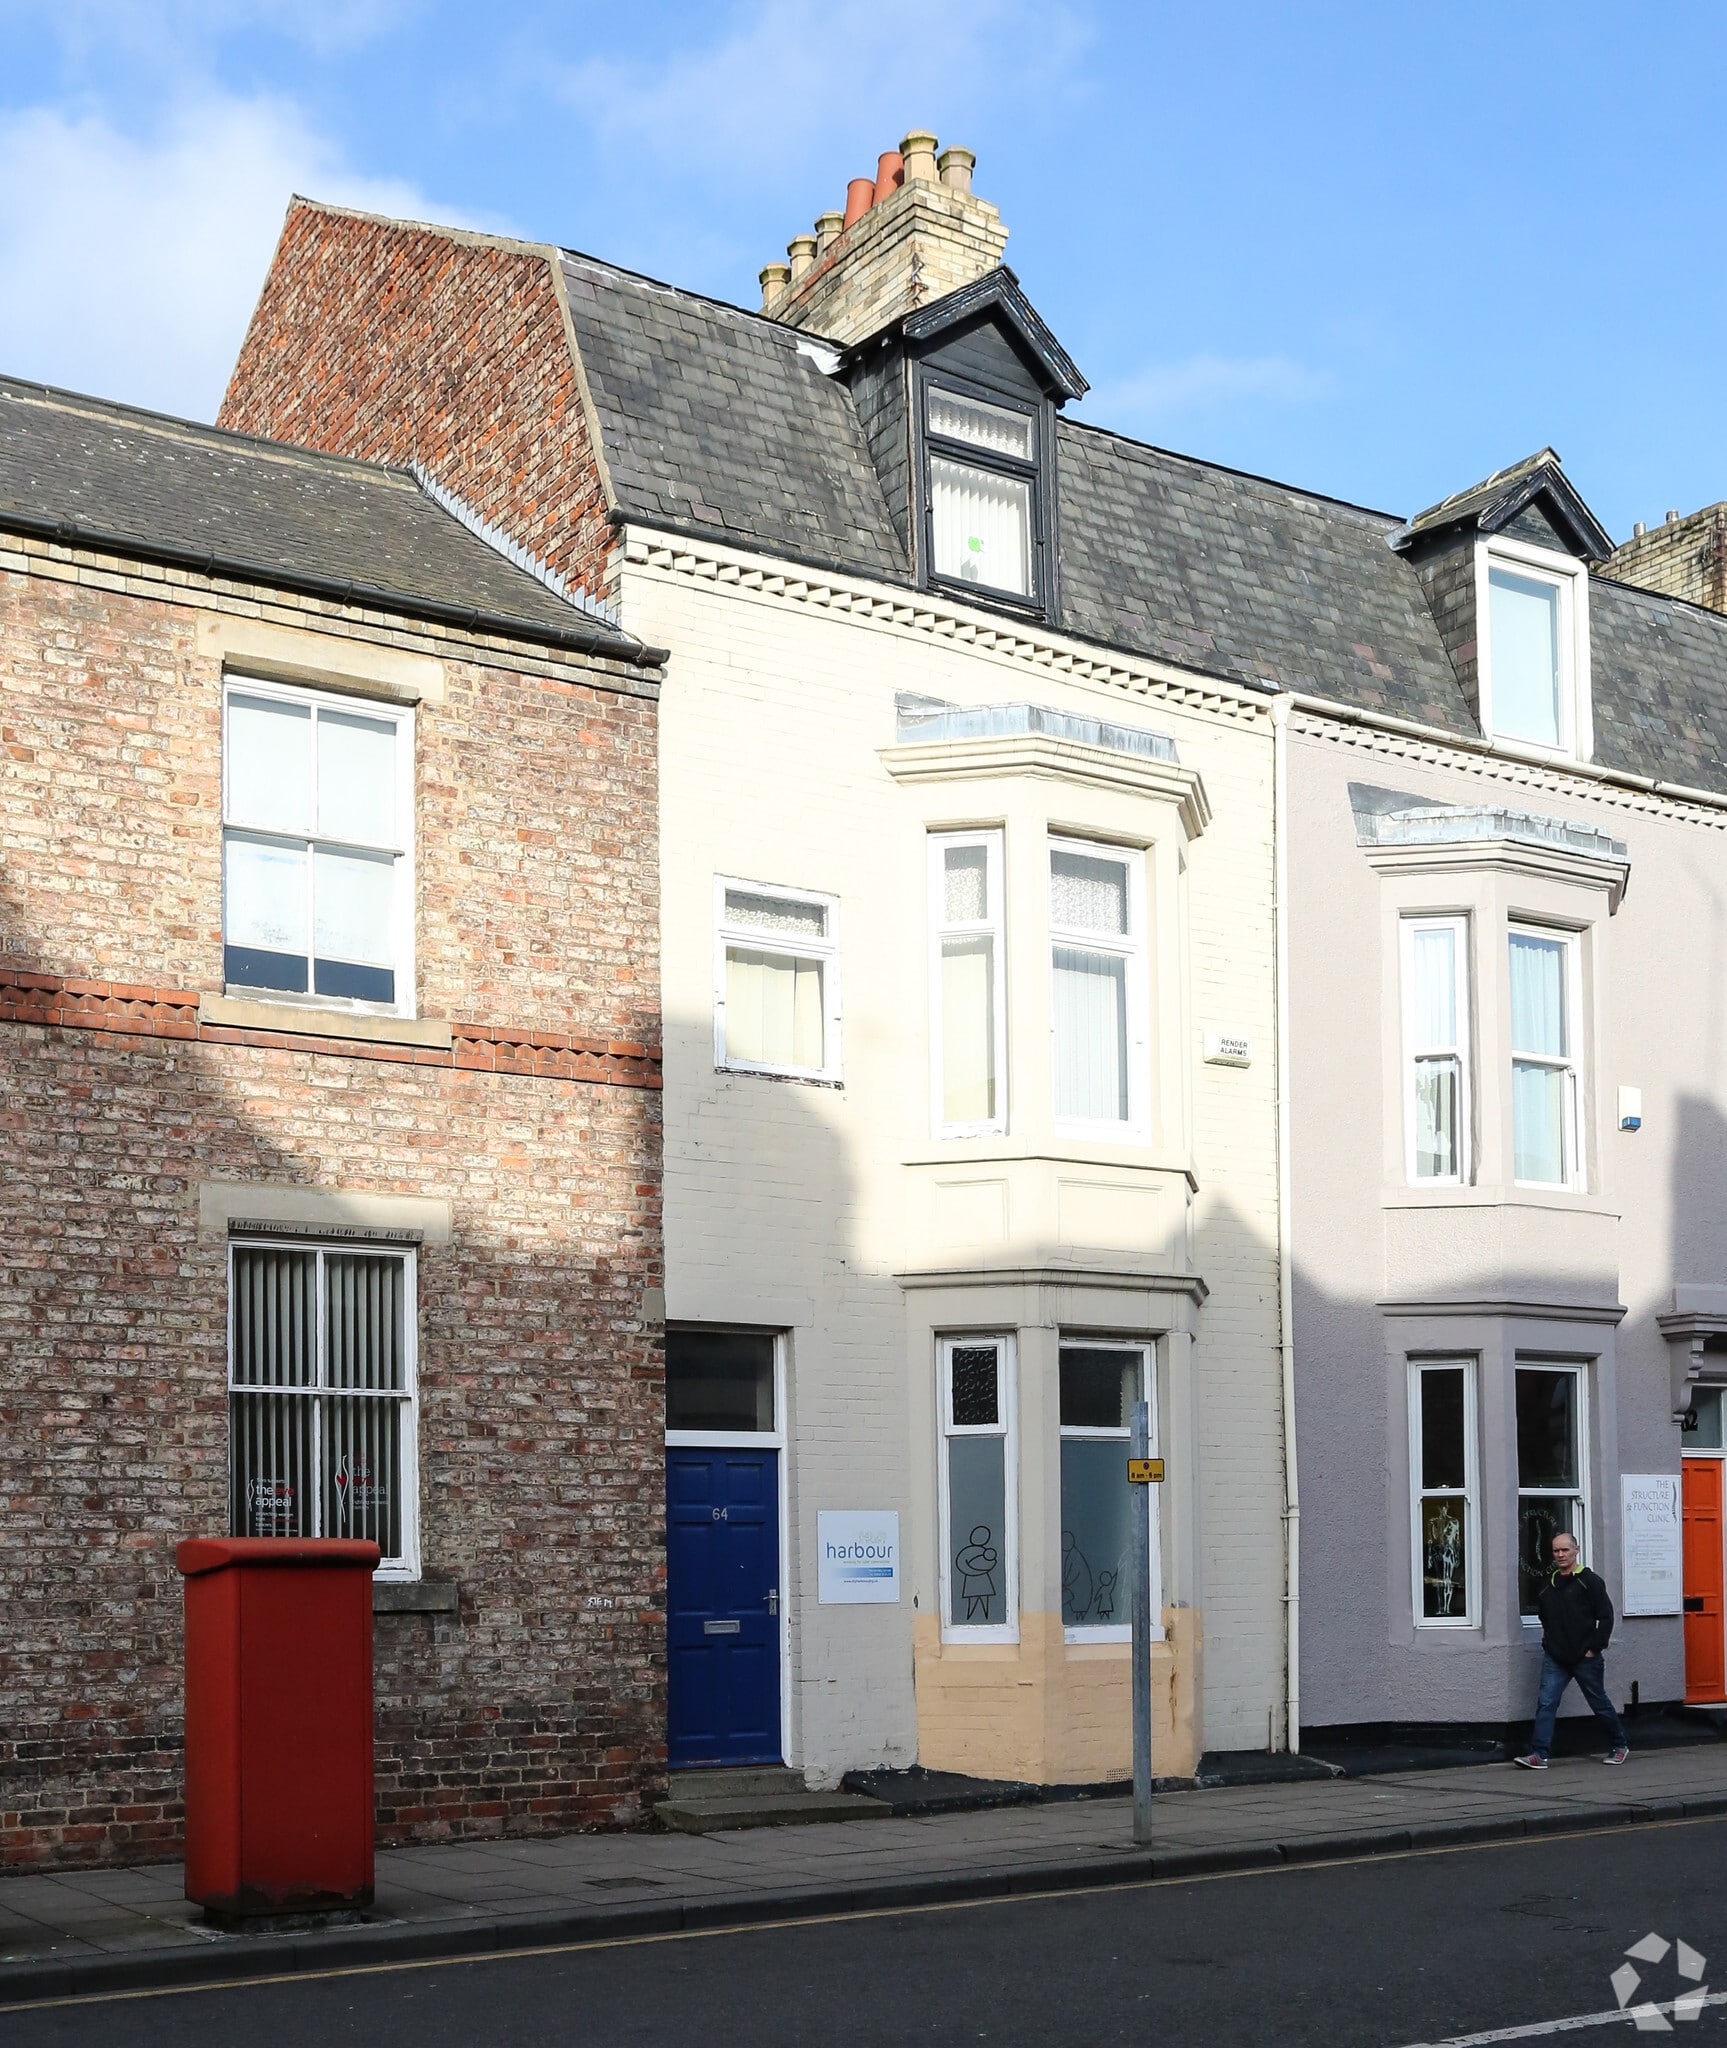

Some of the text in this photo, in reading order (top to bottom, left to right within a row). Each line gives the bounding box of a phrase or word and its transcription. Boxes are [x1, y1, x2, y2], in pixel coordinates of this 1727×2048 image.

[1221, 1038, 1248, 1048] RENDER
[1220, 1047, 1247, 1056] ALARMS
[1656, 1479, 1669, 1489] THE
[256, 1485, 295, 1496] the eve
[1631, 1490, 1670, 1500] STRUCTURE
[255, 1496, 292, 1509] appeal
[1626, 1501, 1670, 1512] & FUNCTION
[712, 1507, 728, 1521] 64
[1647, 1513, 1670, 1523] CLINIC
[826, 1541, 893, 1559] harbour
